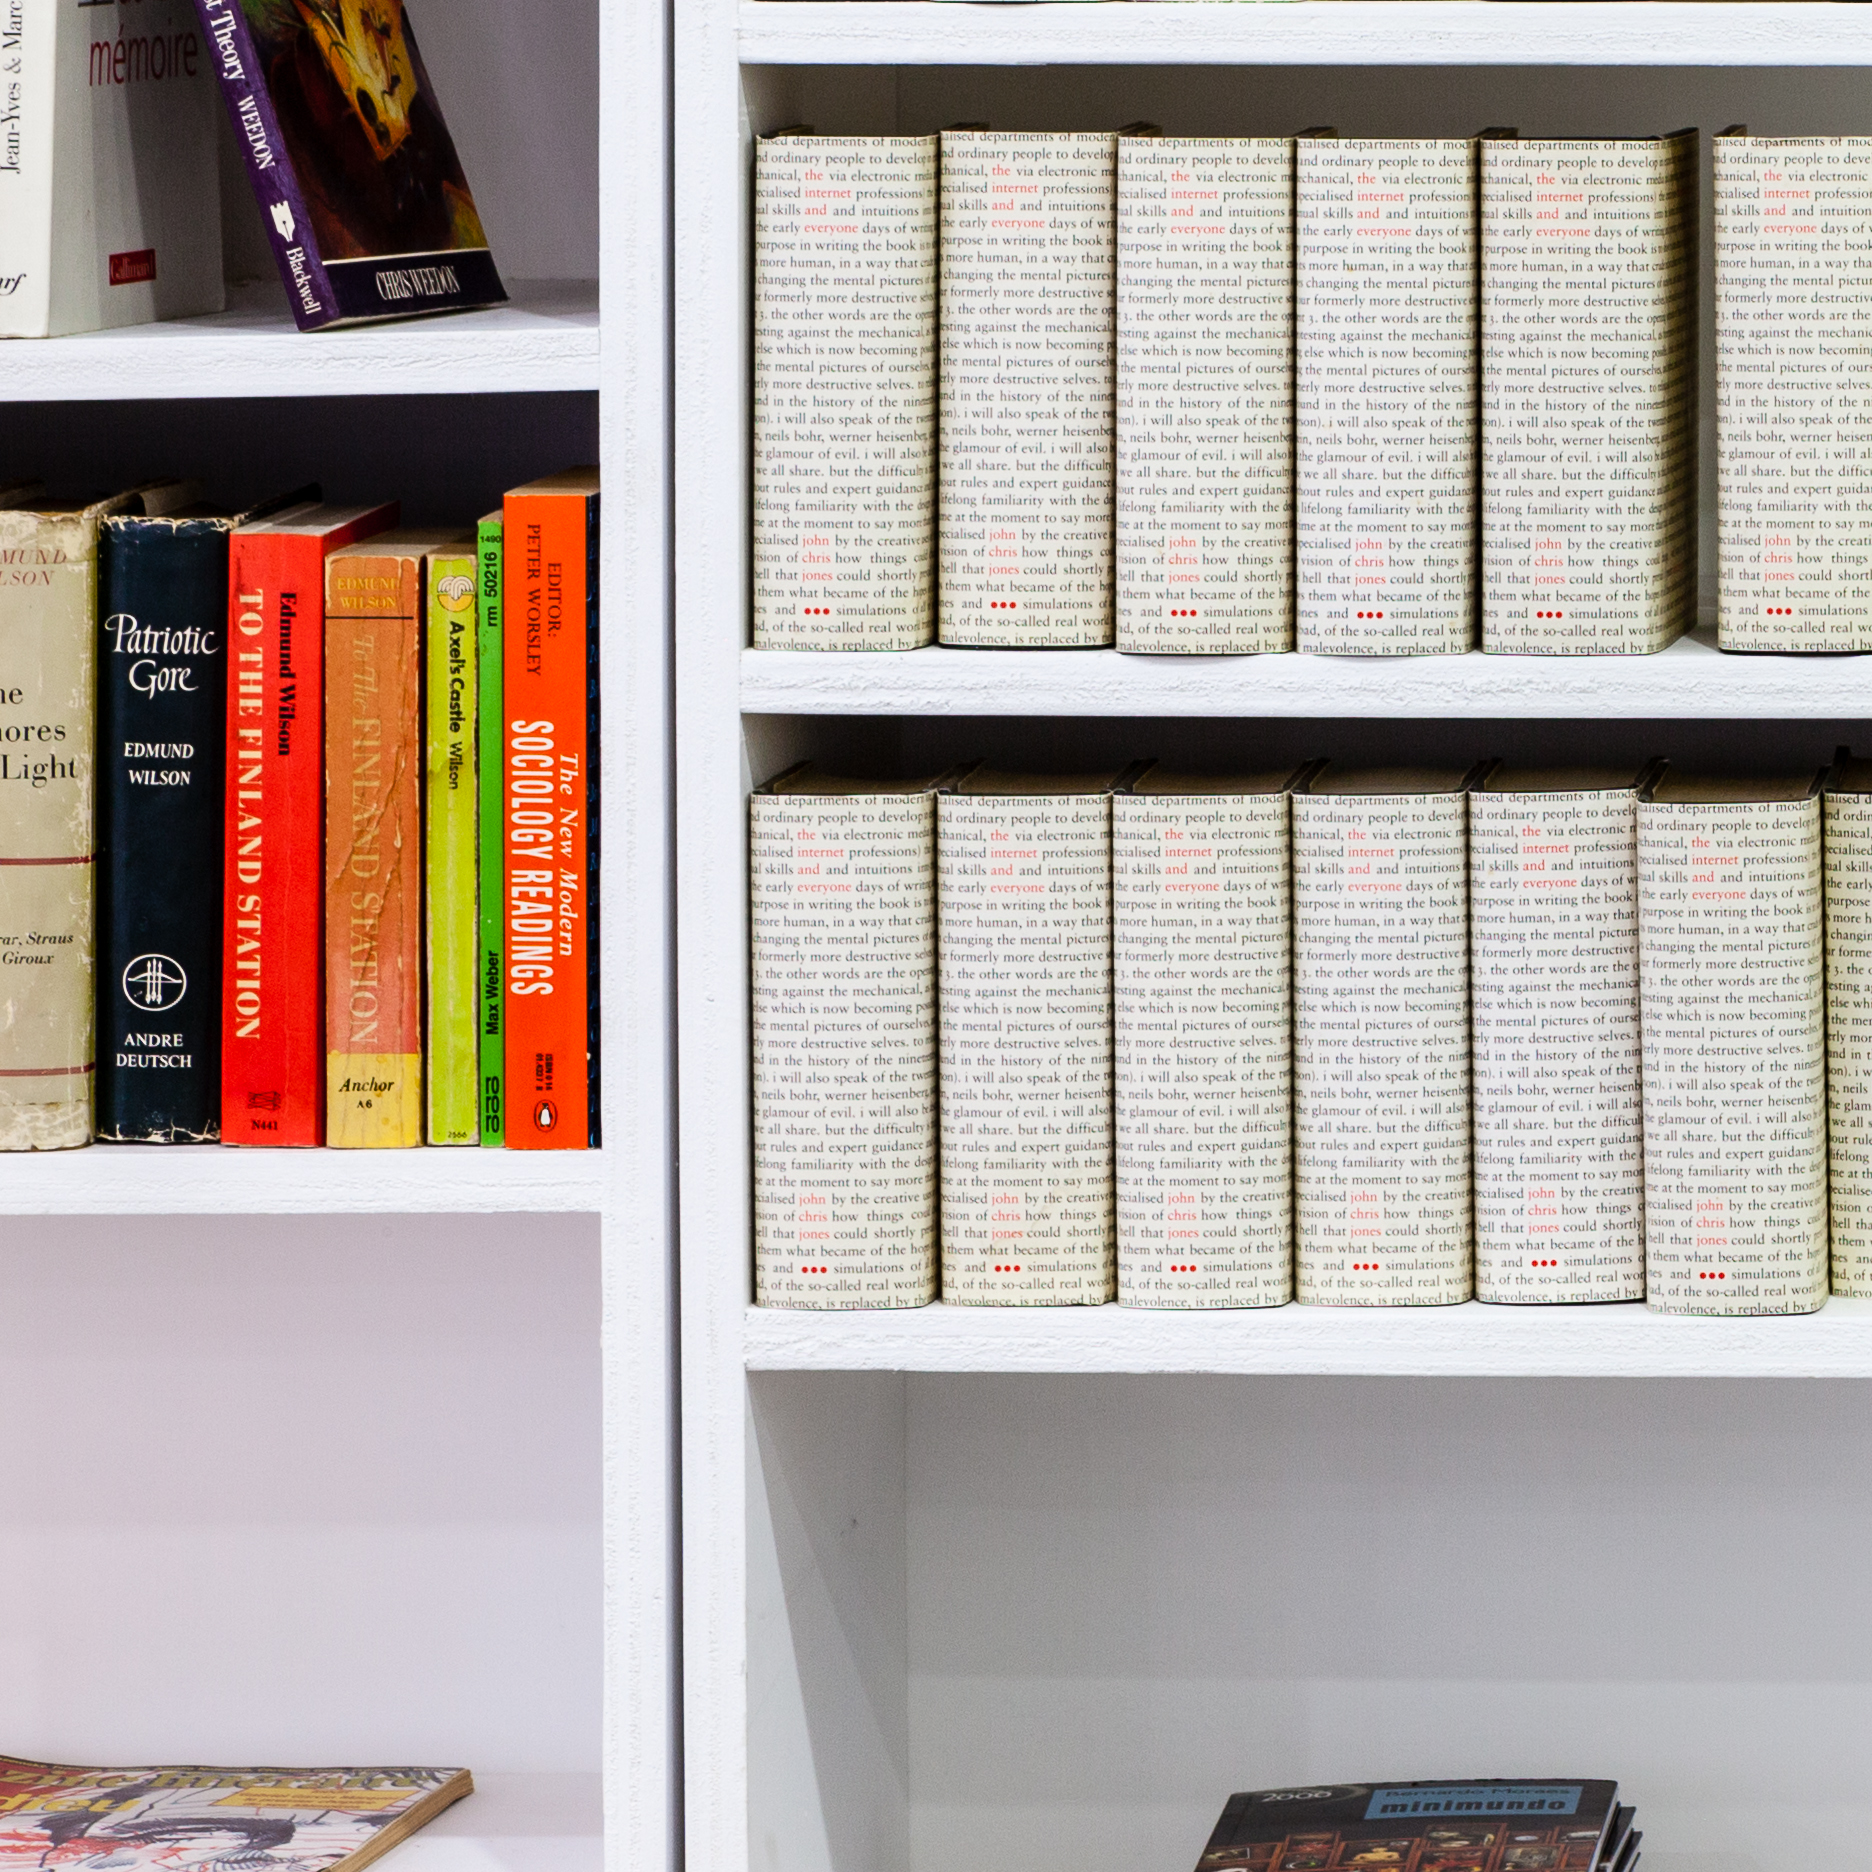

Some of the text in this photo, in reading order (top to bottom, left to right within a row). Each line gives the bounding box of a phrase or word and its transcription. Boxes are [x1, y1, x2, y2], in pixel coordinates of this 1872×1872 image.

[238, 95, 275, 169] WEEDON
[1764, 225, 1816, 233] everyone
[285, 249, 321, 315] Blackwell
[105, 614, 217, 654] Patriotic
[1773, 621, 1825, 633] so-called
[129, 659, 198, 699] Gore
[449, 621, 466, 789] Axel's Castle Wilson
[124, 742, 194, 758] EDMUND
[129, 770, 190, 785] WILSON
[237, 589, 263, 1038] TO THE FINLAND STATION
[511, 721, 554, 994] SOCIOLOGY READINGS
[125, 1033, 183, 1047] ANDRE
[117, 1053, 191, 1068] DEUTSCH
[872, 1140, 923, 1155] guidance
[1380, 1799, 1565, 1813] minimundo
